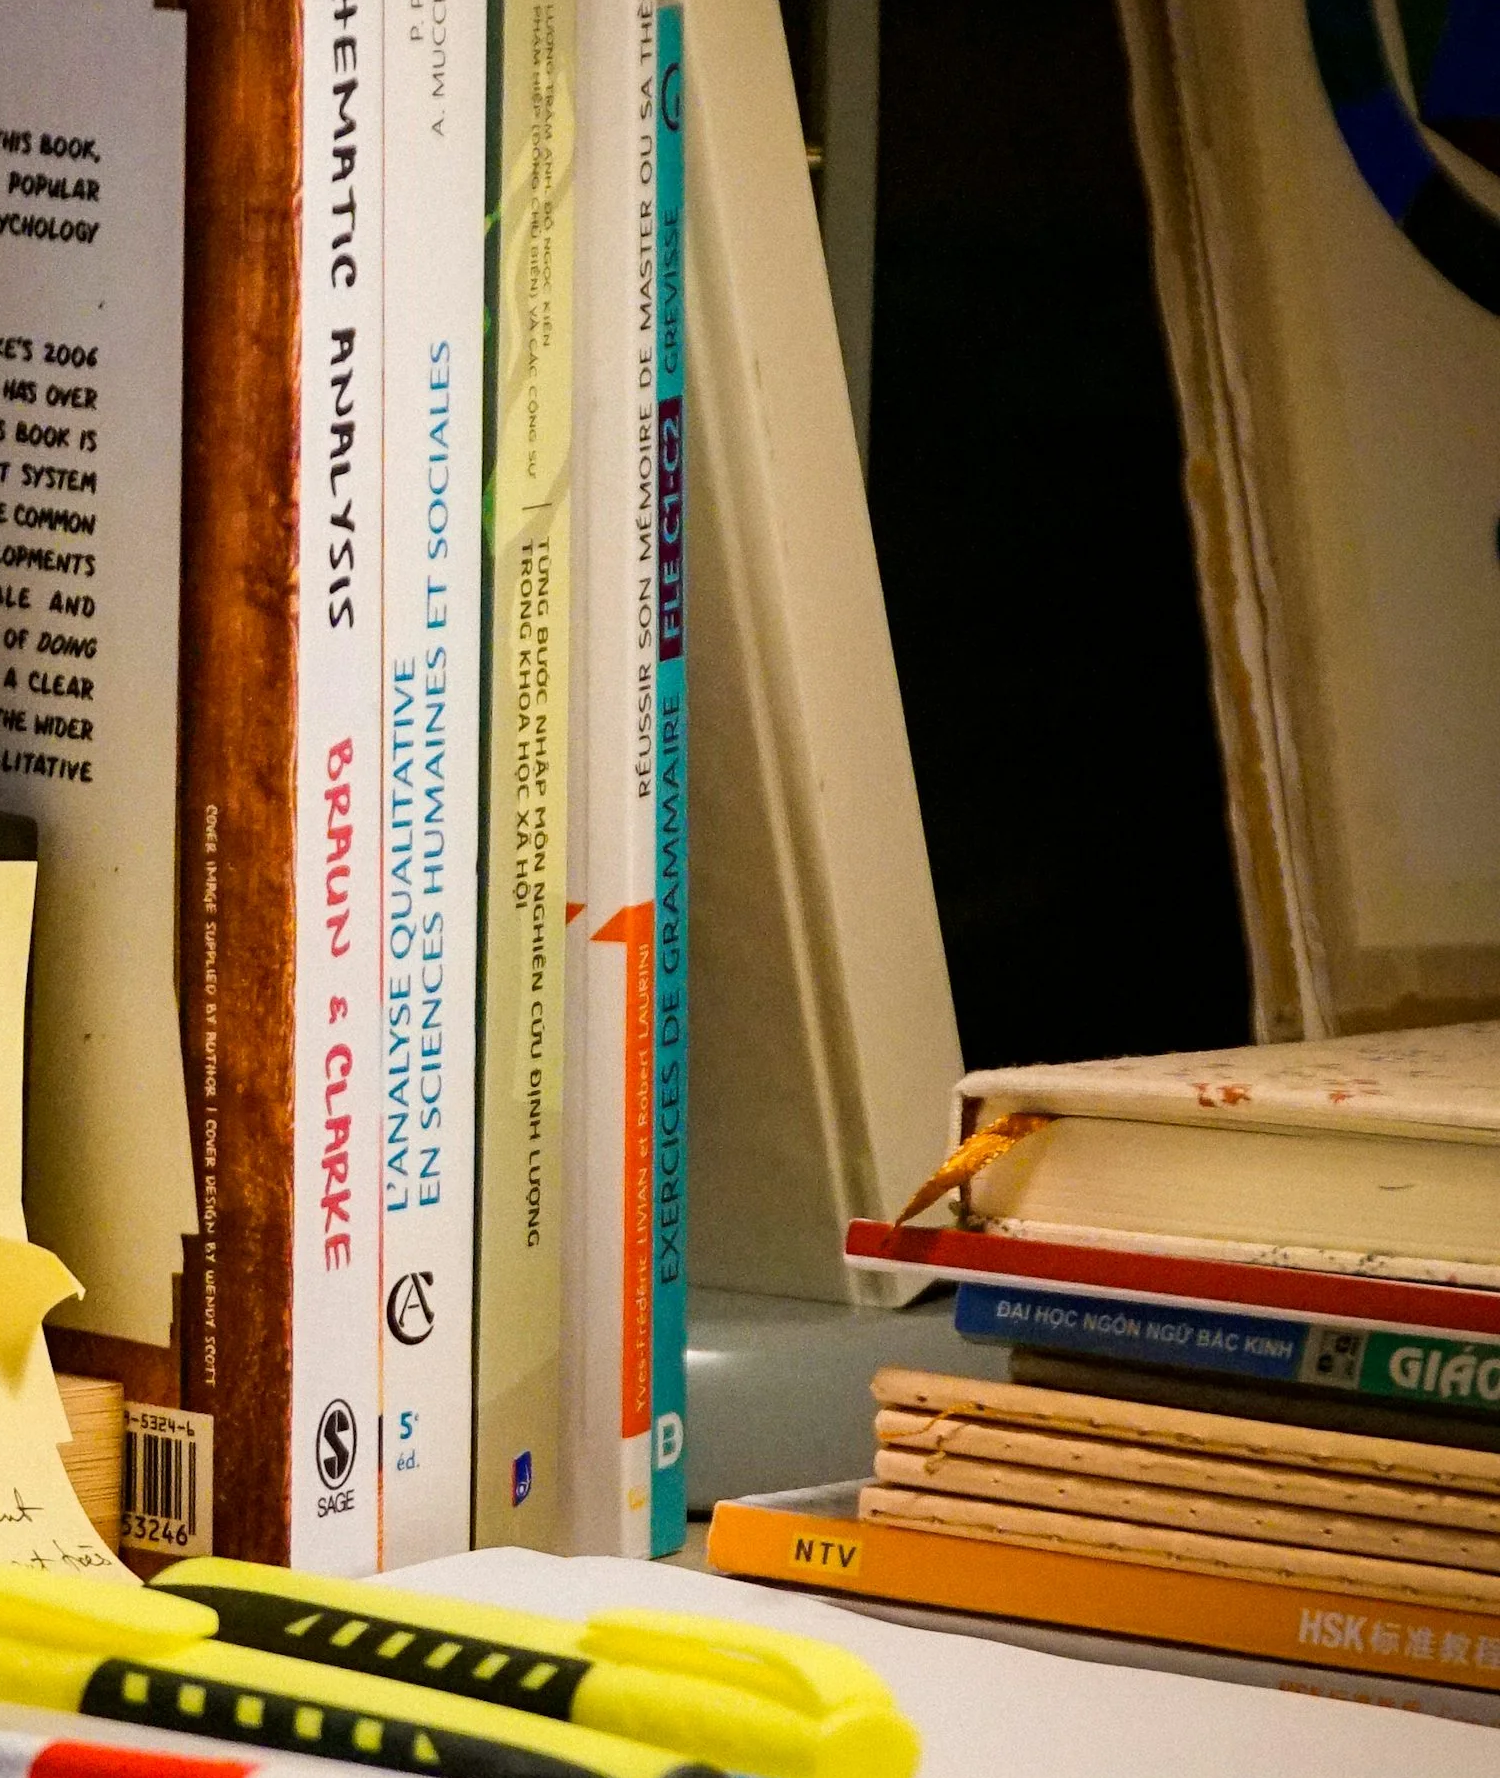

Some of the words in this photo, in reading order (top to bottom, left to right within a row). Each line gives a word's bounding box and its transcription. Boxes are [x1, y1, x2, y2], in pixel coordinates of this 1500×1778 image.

[409, 19, 424, 42] P.
[431, 110, 445, 136] A.
[640, 76, 652, 120] SA
[39, 134, 100, 163] BOOK,
[640, 135, 652, 185] OU
[8, 171, 99, 201] POPULAR
[640, 201, 652, 331] MASTER
[664, 207, 679, 374] GREVISSE
[44, 343, 98, 368] 2006
[639, 348, 652, 389] DE
[3, 379, 36, 404] HAS
[46, 384, 97, 409] OVER
[15, 421, 69, 448] BOOK
[80, 430, 97, 452] IS
[428, 342, 449, 559] SOCIALES
[22, 463, 96, 494] SYSTEM
[329, 328, 355, 628] ANALYSIS
[636, 404, 651, 560] MÉMOIRE
[662, 415, 684, 545] C1-C2
[14, 504, 95, 535] COMMON
[49, 591, 95, 618] AND
[427, 578, 446, 629] ET
[520, 541, 534, 639] TRONG
[538, 537, 549, 616] TỪNG
[663, 561, 683, 639] FLE
[639, 577, 651, 649] SON
[3, 628, 29, 650] OF
[36, 632, 97, 659] DOING
[536, 627, 549, 703] BƯỚC
[3, 667, 17, 689] A
[28, 671, 94, 700] CLEAR
[518, 650, 531, 732] KHOA
[34, 715, 93, 740] WIDER
[535, 715, 549, 796] NHẬP
[635, 664, 651, 798] RÉUSSIR
[423, 647, 446, 894] HUMAINES
[514, 742, 529, 799] HỌC
[205, 804, 218, 853] COVER
[390, 659, 416, 959] QUALITATIVE
[516, 811, 530, 850] XÃ
[663, 696, 680, 974] GRAMMAIRE
[324, 738, 353, 957] BRAUN
[534, 807, 548, 872] MÔN
[513, 860, 530, 909] HỘI
[205, 922, 217, 995] SUPPLIED
[531, 883, 546, 992] NGHIÊN
[206, 1004, 217, 1025] BY
[420, 911, 444, 1131] SCIENCES
[530, 1001, 542, 1059] CỨU
[662, 991, 680, 1047] DE
[205, 1031, 217, 1096] AUTHOR
[386, 973, 411, 1214] L'ANALYSE
[528, 1069, 541, 1140] ĐỊNH
[205, 1119, 217, 1167] COVER
[321, 1044, 352, 1271] CLARKE
[418, 1147, 441, 1207] EN
[526, 1150, 540, 1247] LƯỢNG
[660, 1062, 680, 1285] EXERCICES
[204, 1176, 216, 1233] DESIGN
[205, 1242, 216, 1262] BY
[205, 1270, 216, 1328] WENDY
[205, 1336, 216, 1387] SCOTT
[1034, 1306, 1077, 1330] HỌC
[1082, 1313, 1140, 1337] NGÔN
[1243, 1337, 1293, 1359] KINH
[318, 1490, 355, 1518] SAGE
[795, 1539, 856, 1568] NTV
